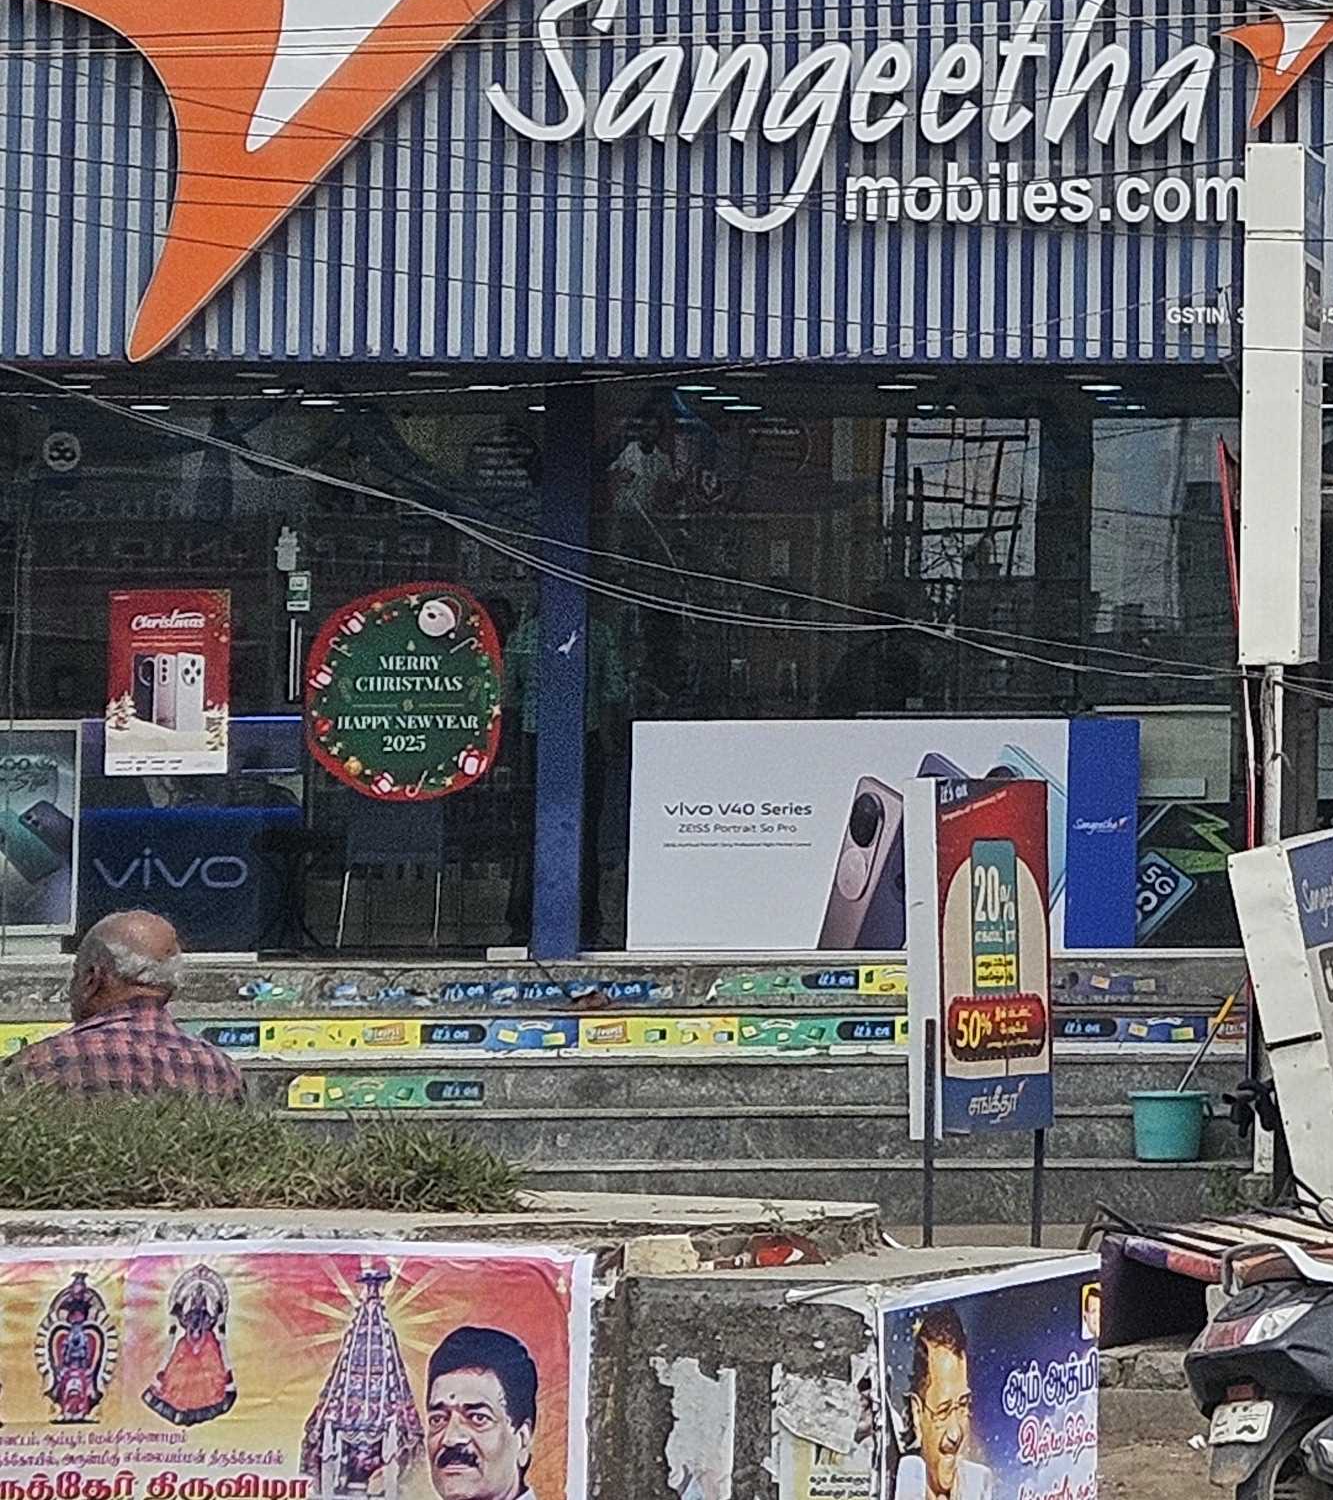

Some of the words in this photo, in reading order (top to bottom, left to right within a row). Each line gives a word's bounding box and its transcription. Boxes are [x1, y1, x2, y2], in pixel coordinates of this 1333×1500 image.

[845, 163, 1246, 223] mobiles.com
[131, 608, 205, 631] Christmas
[379, 655, 442, 671] MERRY
[355, 677, 463, 691] CHRISTMAS
[337, 715, 394, 730] HAPPY
[395, 715, 435, 730] NEW
[435, 715, 479, 730] YEAR
[383, 735, 426, 751] 2025
[664, 802, 713, 816] vivo
[718, 803, 755, 816] V40
[761, 803, 812, 816] Series
[678, 823, 710, 833] ZEISS
[713, 823, 756, 833] Portrait
[760, 823, 774, 833] So
[777, 823, 798, 833] Pro
[93, 846, 250, 892] vivo
[1142, 866, 1175, 895] 5G
[974, 864, 1016, 922] 20%
[956, 1010, 992, 1048] 50%
